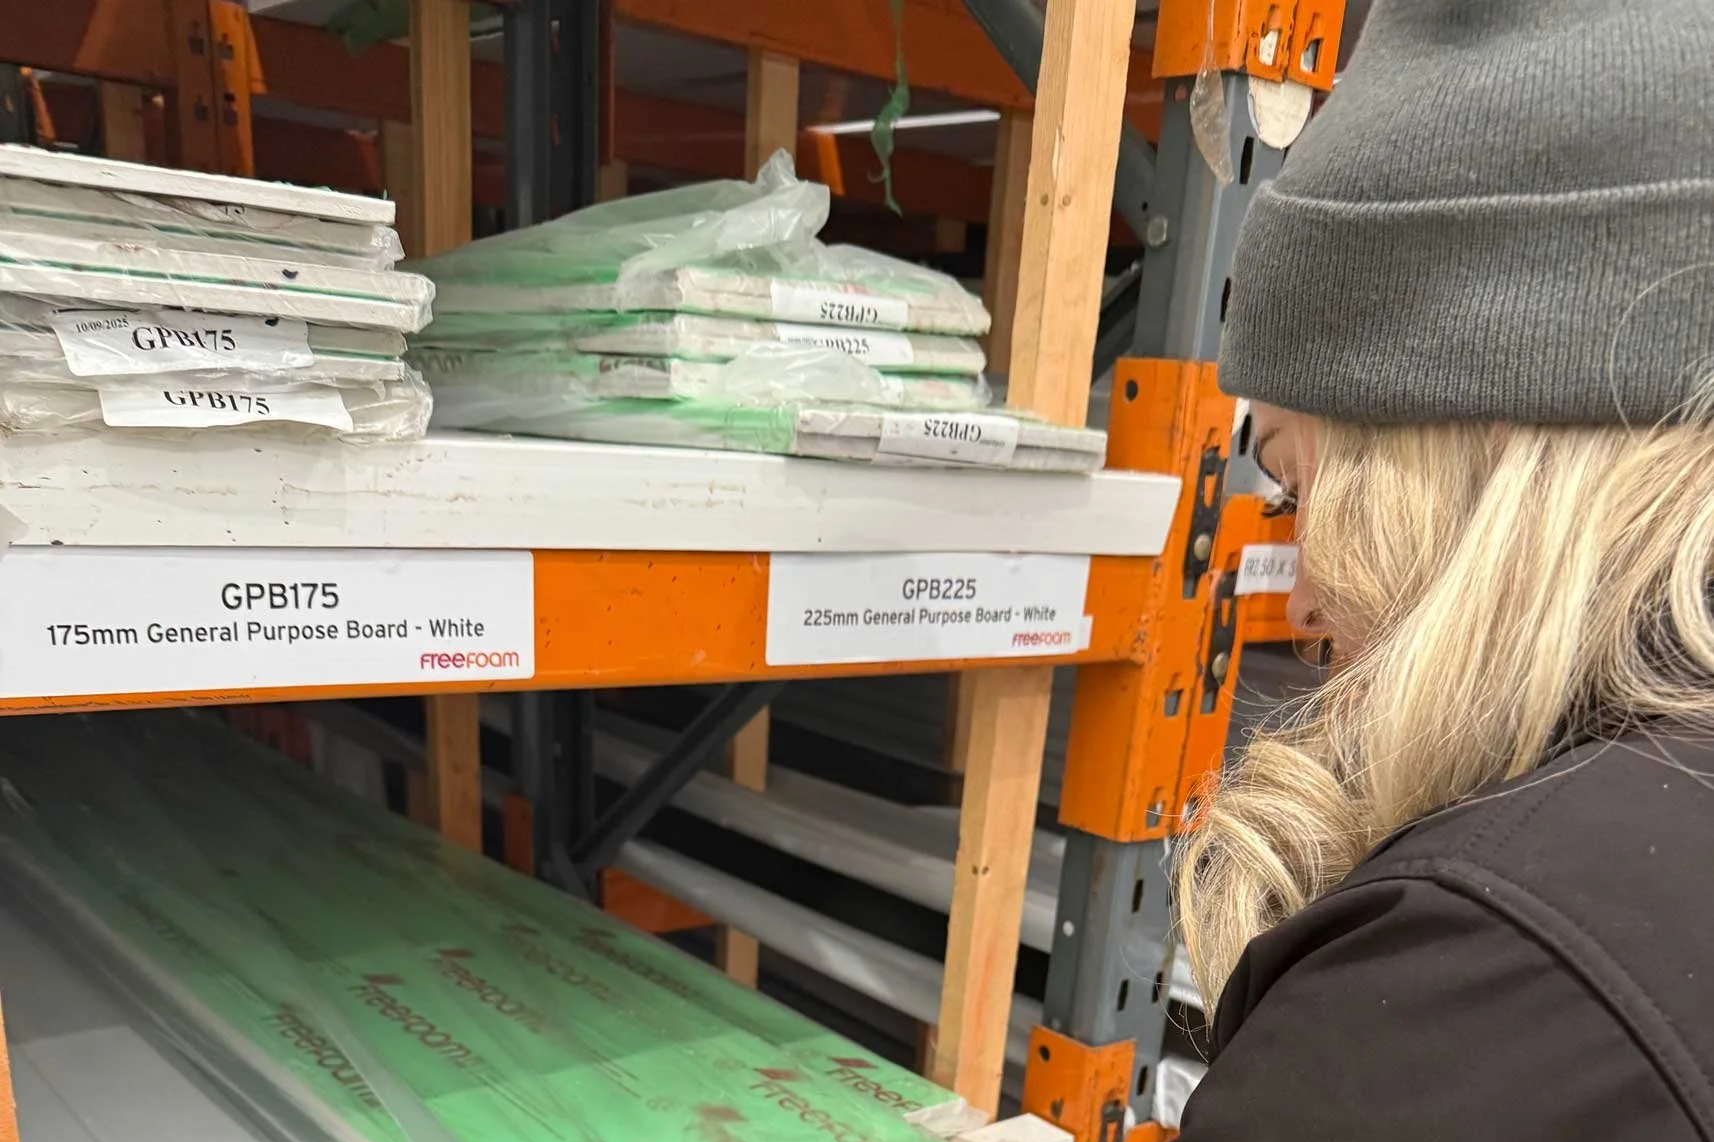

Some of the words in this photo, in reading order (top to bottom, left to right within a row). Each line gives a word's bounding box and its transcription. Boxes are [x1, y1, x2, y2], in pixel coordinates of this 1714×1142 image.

[820, 301, 878, 324] GPB225
[133, 326, 236, 351] GPB175
[163, 391, 270, 415] GPB175
[924, 419, 982, 443] GPB225
[222, 583, 340, 610] GPB175
[902, 578, 977, 600] GPB225
[803, 609, 858, 626] 225mm
[863, 608, 916, 625] General
[919, 607, 972, 626] Purpose
[975, 606, 1012, 623] Board
[1023, 606, 1057, 621] White
[47, 624, 139, 646] 175mm
[147, 622, 239, 643] General
[247, 618, 339, 645] Purpose
[346, 620, 408, 639] Board
[429, 618, 485, 637] White
